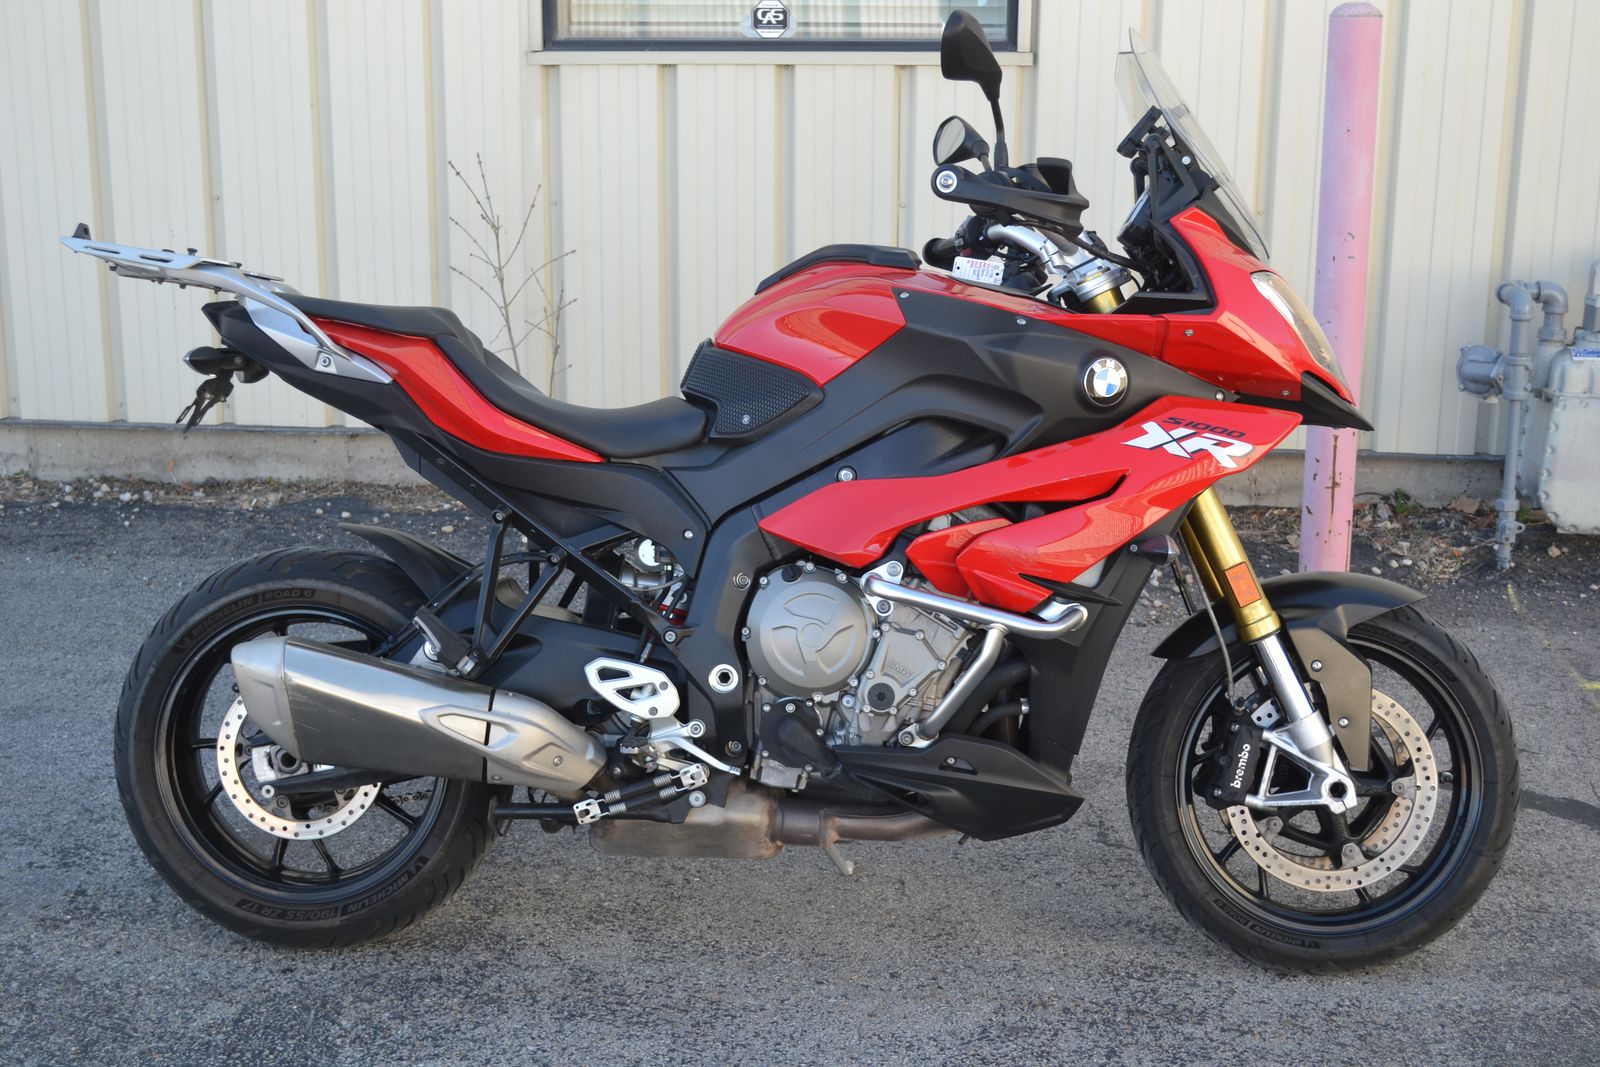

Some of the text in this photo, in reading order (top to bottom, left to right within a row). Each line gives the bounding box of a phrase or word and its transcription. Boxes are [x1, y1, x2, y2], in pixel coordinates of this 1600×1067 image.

[1091, 359, 1127, 378] BMW
[1121, 421, 1253, 469] XR
[1162, 417, 1246, 438] S1000
[192, 597, 254, 636] MICHELIN
[265, 590, 300, 601] ROAD
[1230, 743, 1250, 789] brembo
[240, 873, 409, 921] MICHELIN 190/55 ZR 17
